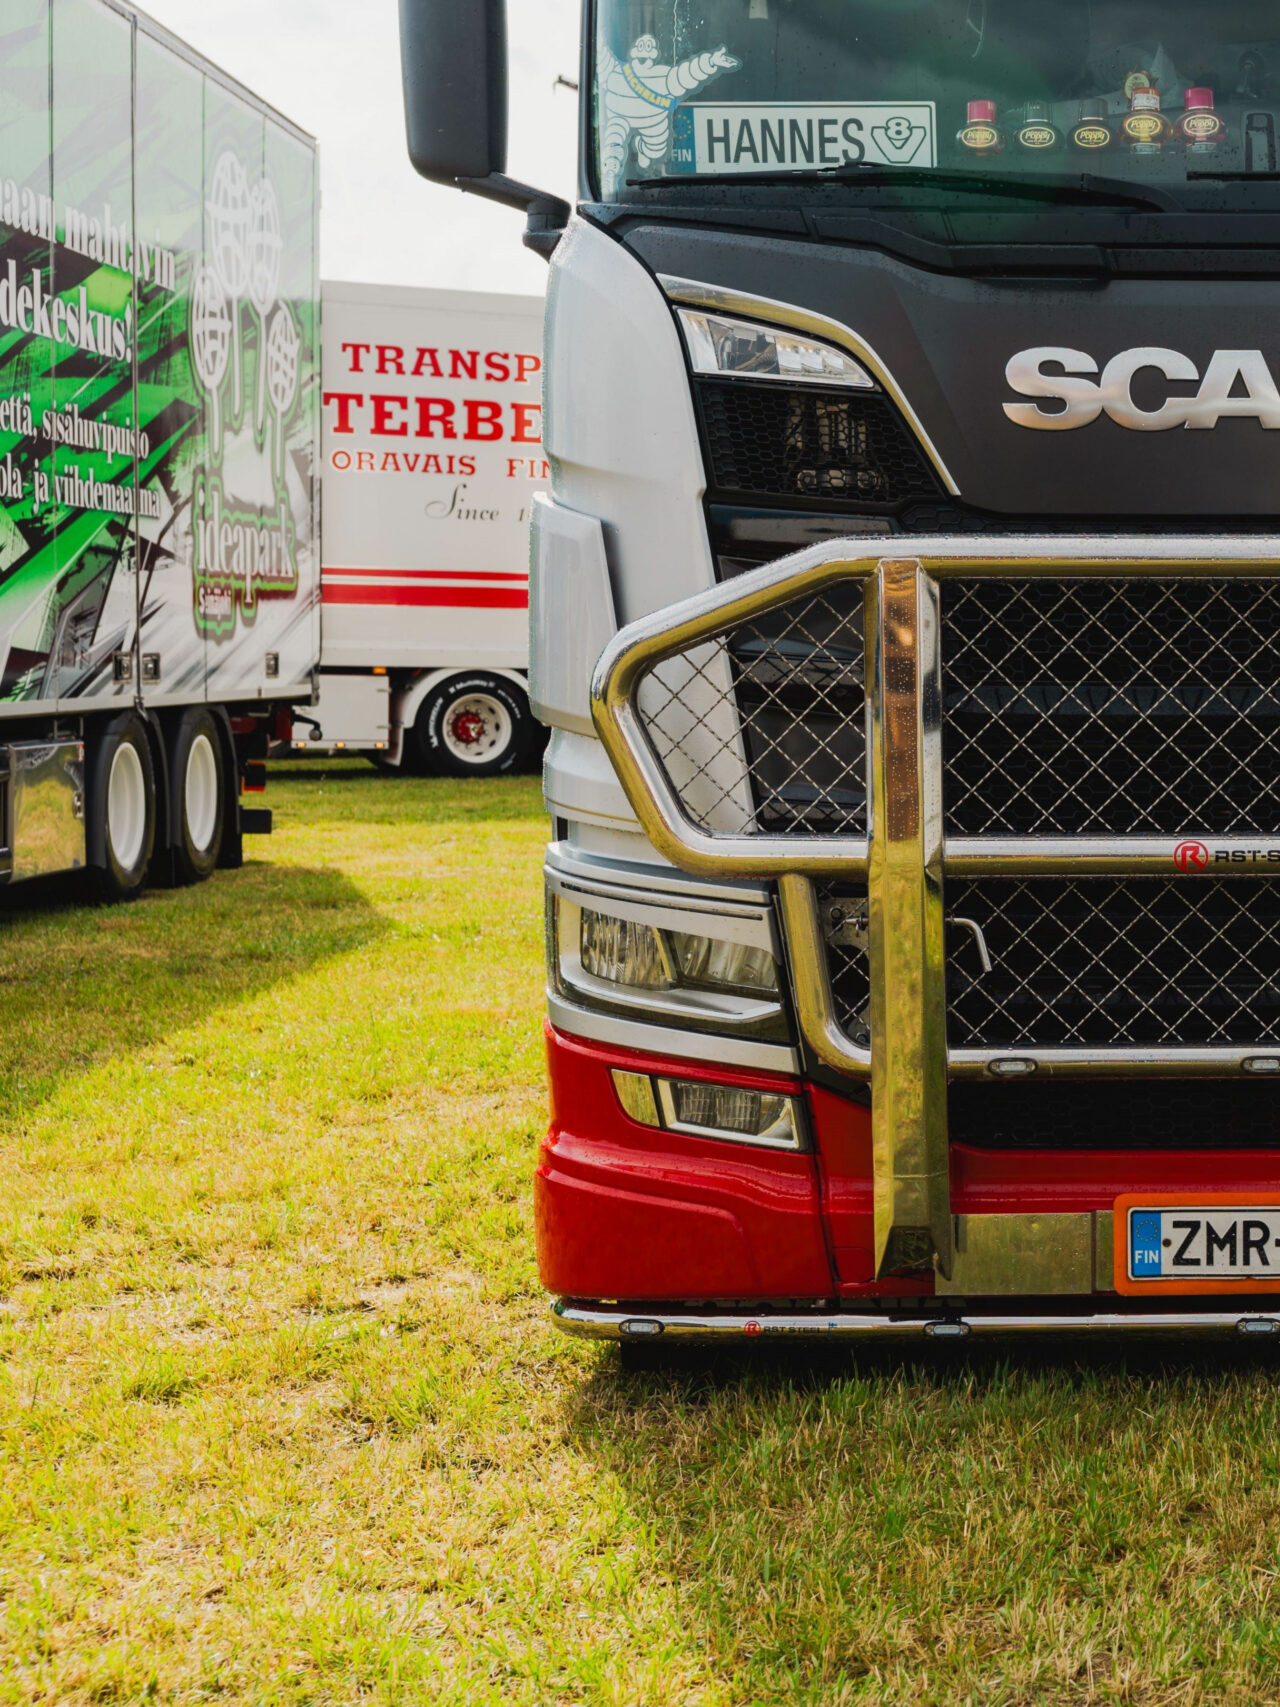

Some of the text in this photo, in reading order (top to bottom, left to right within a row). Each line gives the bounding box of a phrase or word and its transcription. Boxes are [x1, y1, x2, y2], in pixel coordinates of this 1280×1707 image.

[622, 62, 672, 109] MICHELIN
[671, 148, 692, 162] FIN
[706, 118, 866, 164] HANNES
[0, 177, 176, 292] aan mahtavin
[341, 342, 542, 383] TRANSP
[322, 391, 542, 444] TERBE
[331, 450, 476, 476] ORAVAIS
[33, 458, 49, 515] ja
[423, 483, 501, 522] Since
[198, 488, 294, 604] ideapark
[1135, 1250, 1159, 1264] FIN
